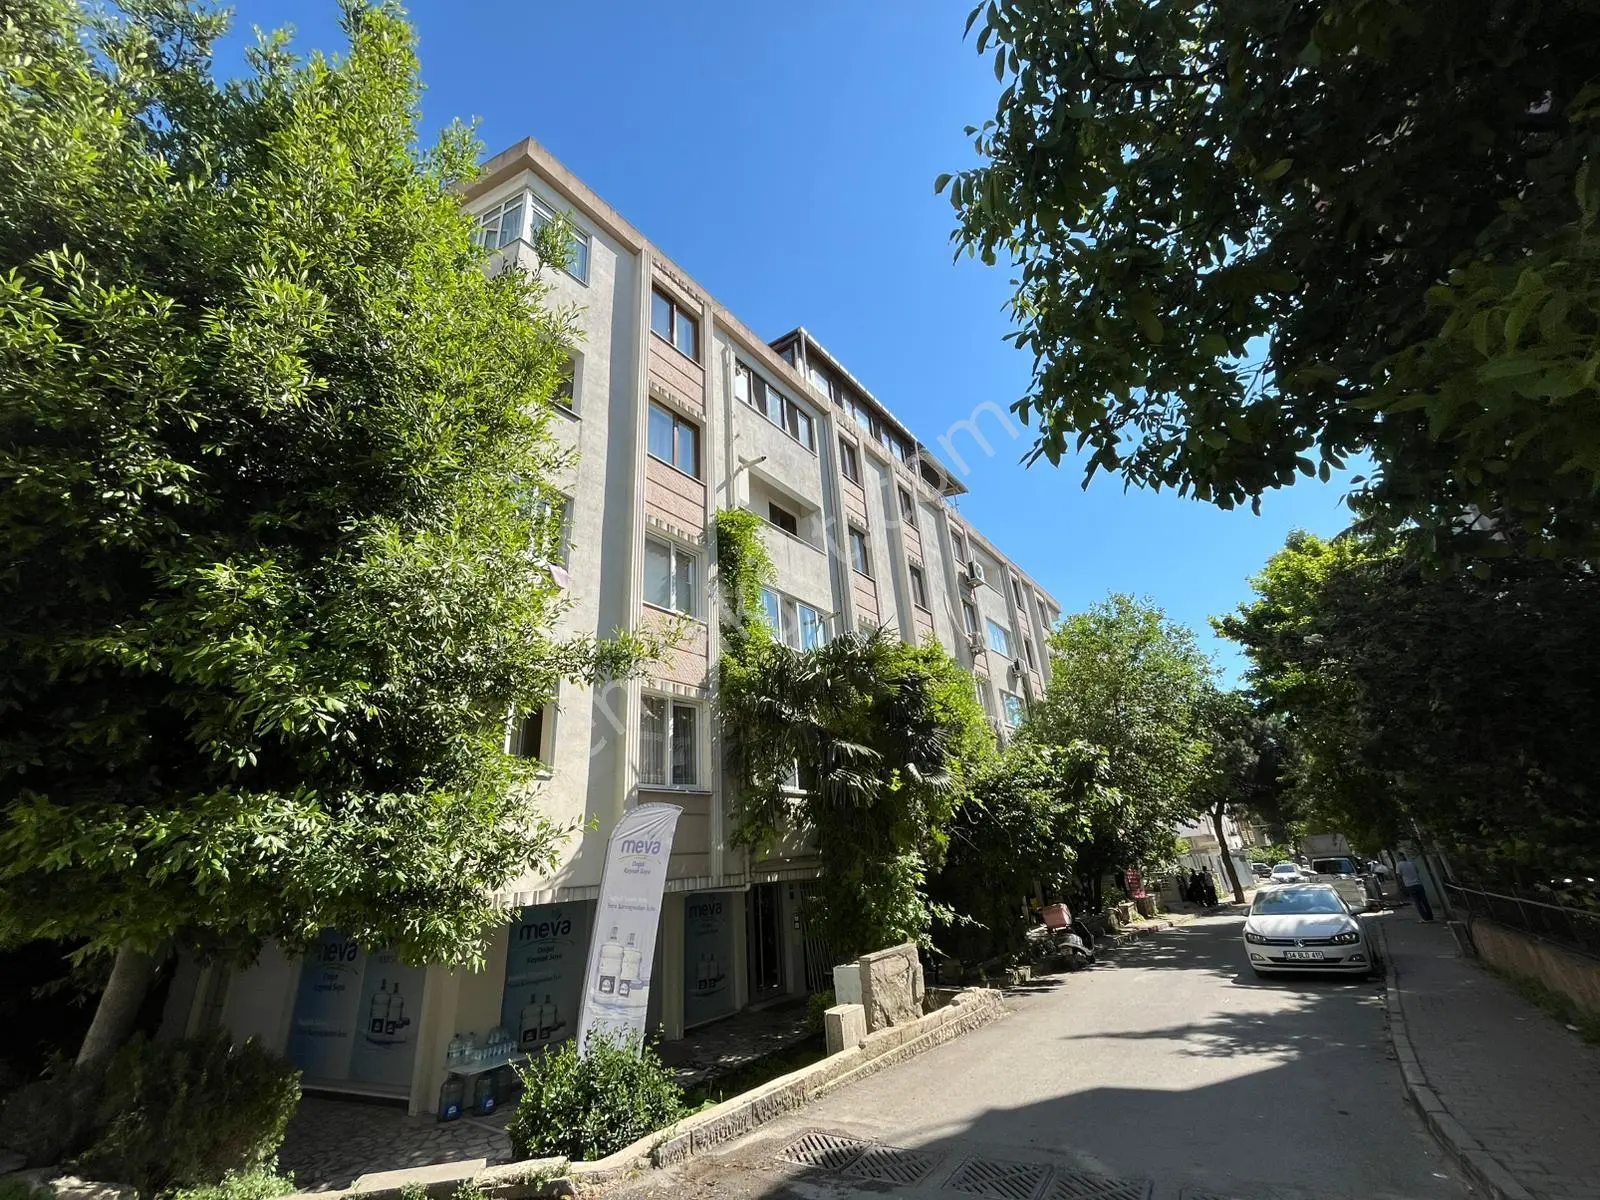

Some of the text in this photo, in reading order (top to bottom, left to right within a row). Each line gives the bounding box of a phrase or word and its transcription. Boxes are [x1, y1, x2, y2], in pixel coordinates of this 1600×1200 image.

[620, 838, 661, 855] meva
[689, 902, 722, 918] meva
[519, 914, 572, 940] meva
